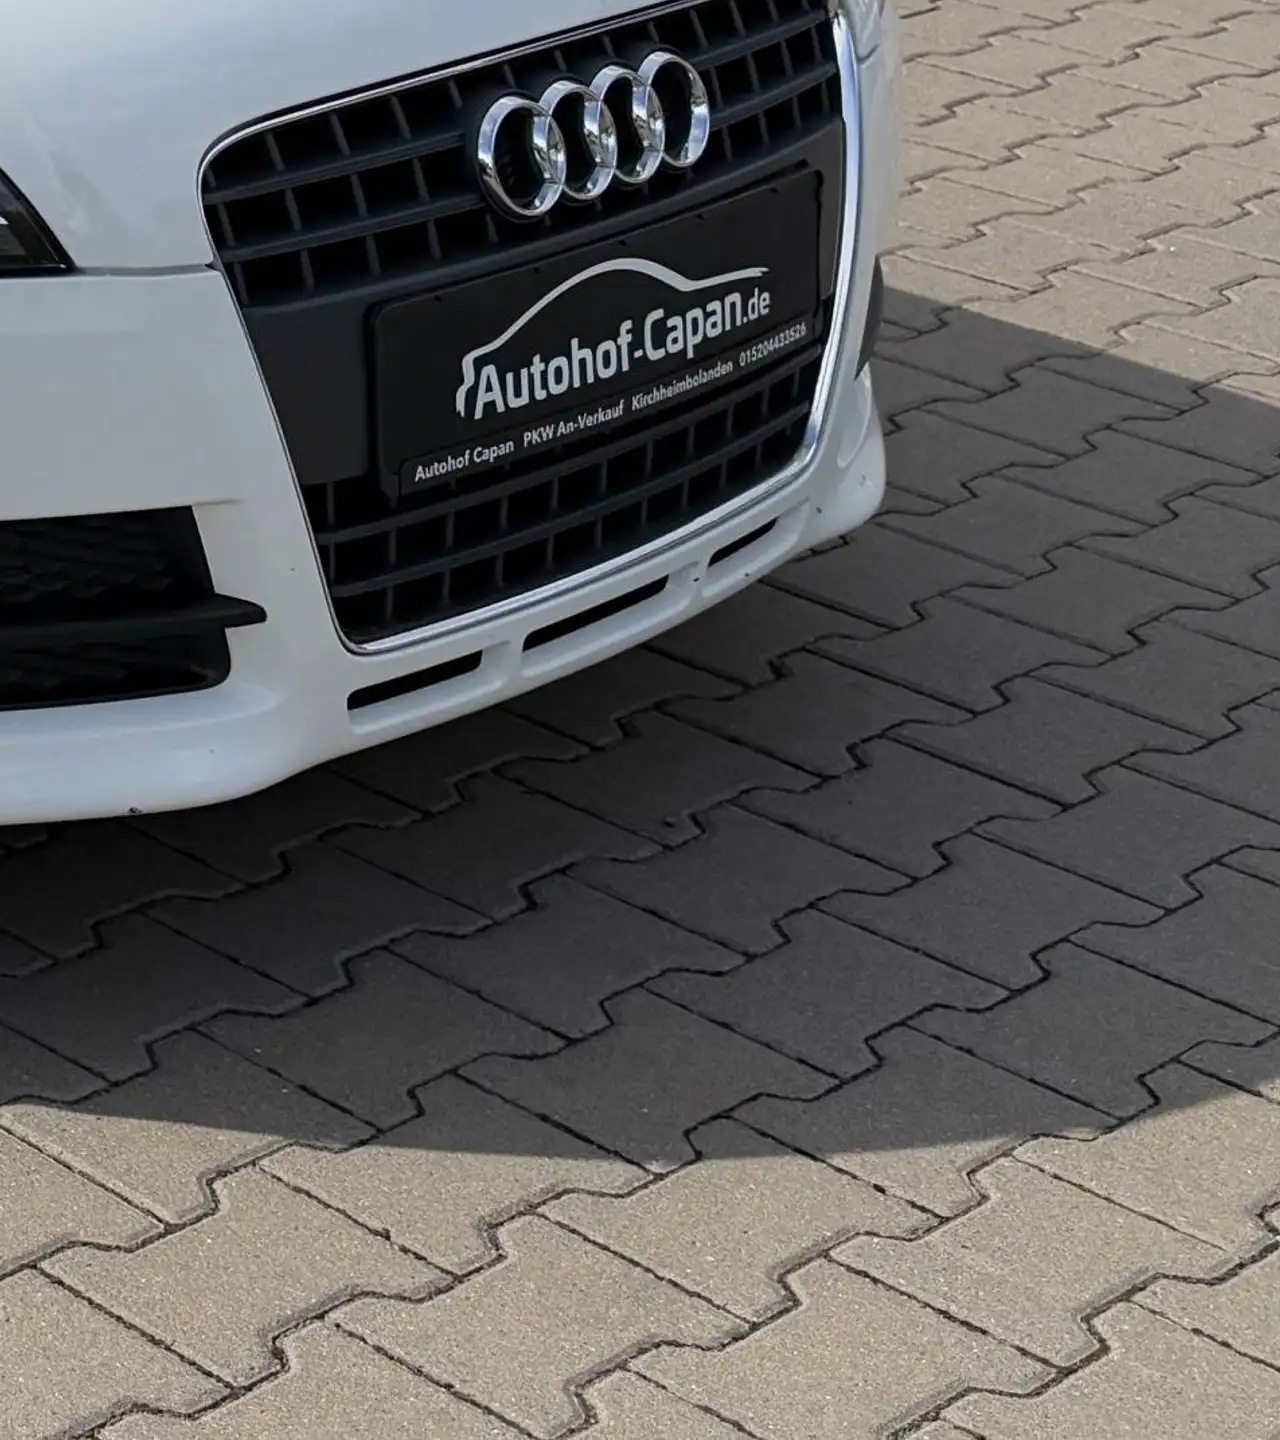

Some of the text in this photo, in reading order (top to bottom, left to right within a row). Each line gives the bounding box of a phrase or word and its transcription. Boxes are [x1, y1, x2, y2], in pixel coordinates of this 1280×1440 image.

[474, 287, 771, 420] Autohof-Capan.de
[414, 449, 471, 482] Autohof
[473, 440, 515, 463] Capan
[523, 424, 555, 447] PKW
[556, 399, 625, 438] An-Verkauf
[631, 361, 733, 411] Kirchheimbolanden
